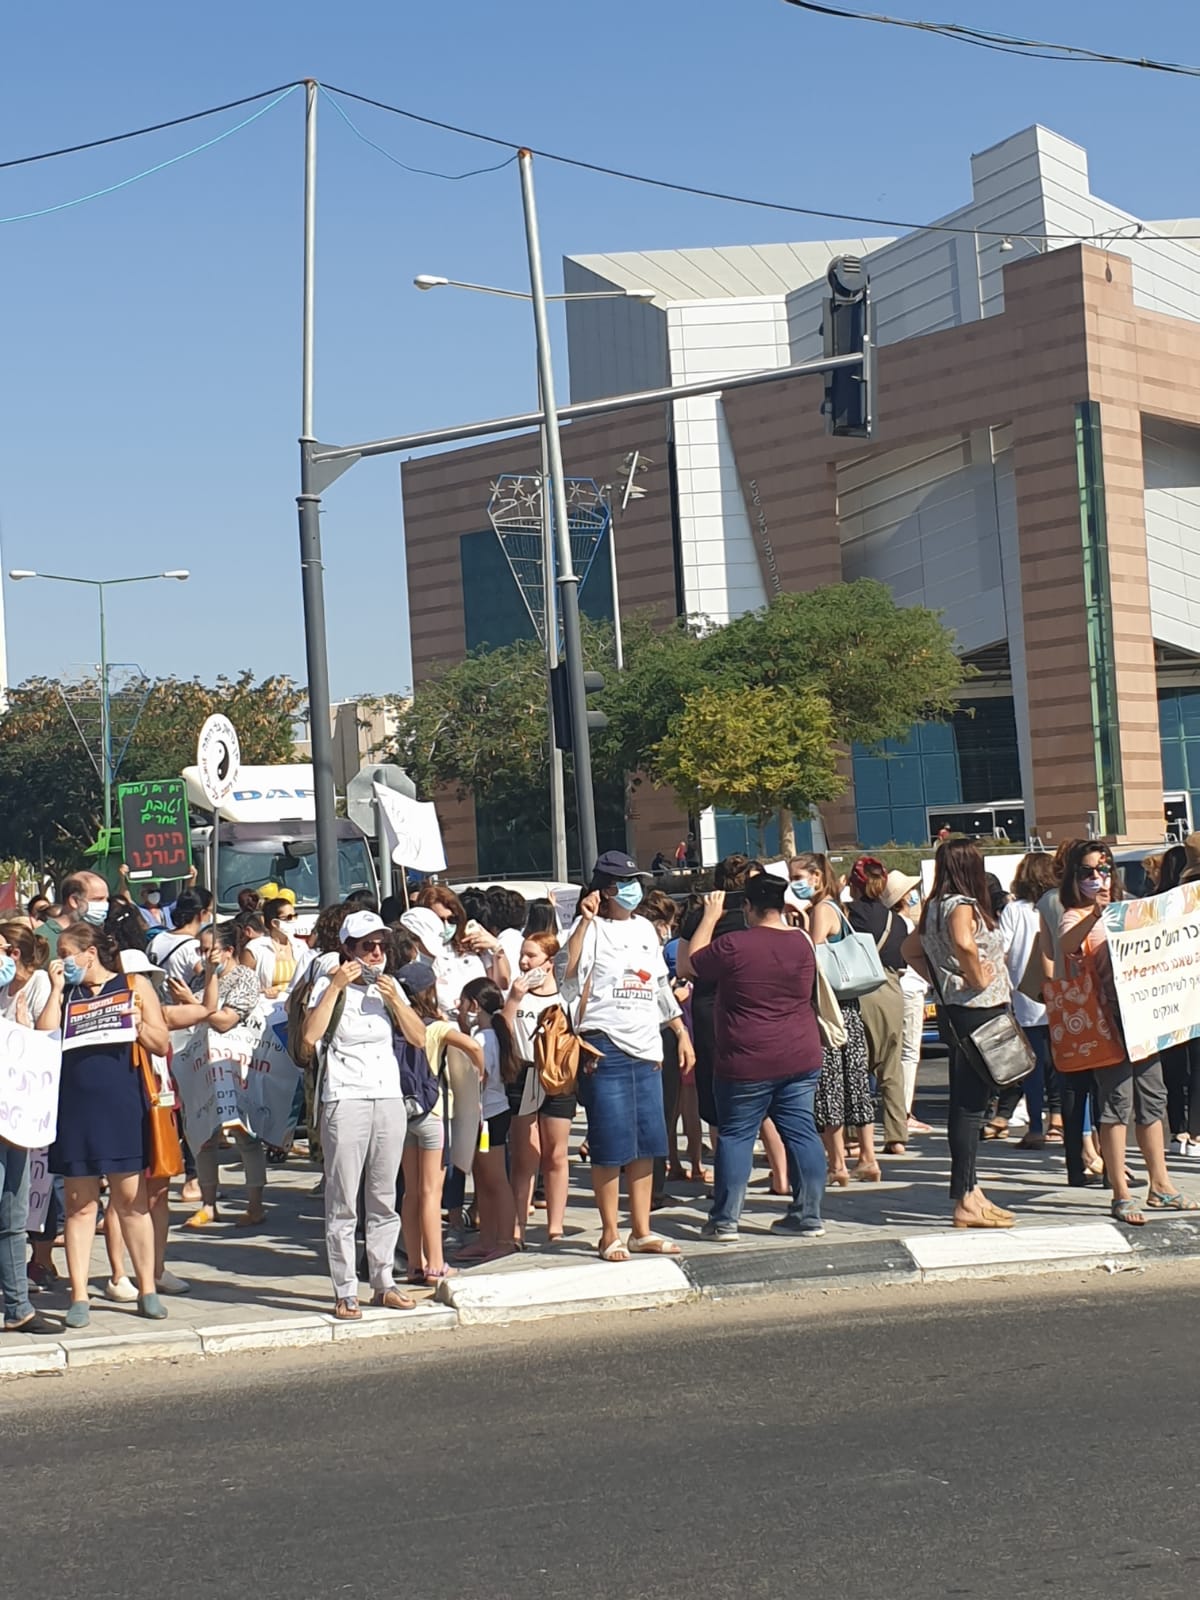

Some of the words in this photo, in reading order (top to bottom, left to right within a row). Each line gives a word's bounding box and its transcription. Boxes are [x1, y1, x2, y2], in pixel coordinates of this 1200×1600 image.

[749, 479, 761, 505] שבע
[758, 511, 768, 534] באר
[140, 798, 182, 814] לטובת
[141, 813, 177, 825] אחרים
[144, 831, 184, 848] היום
[132, 849, 185, 868] תורנו
[1182, 923, 1200, 939] כר
